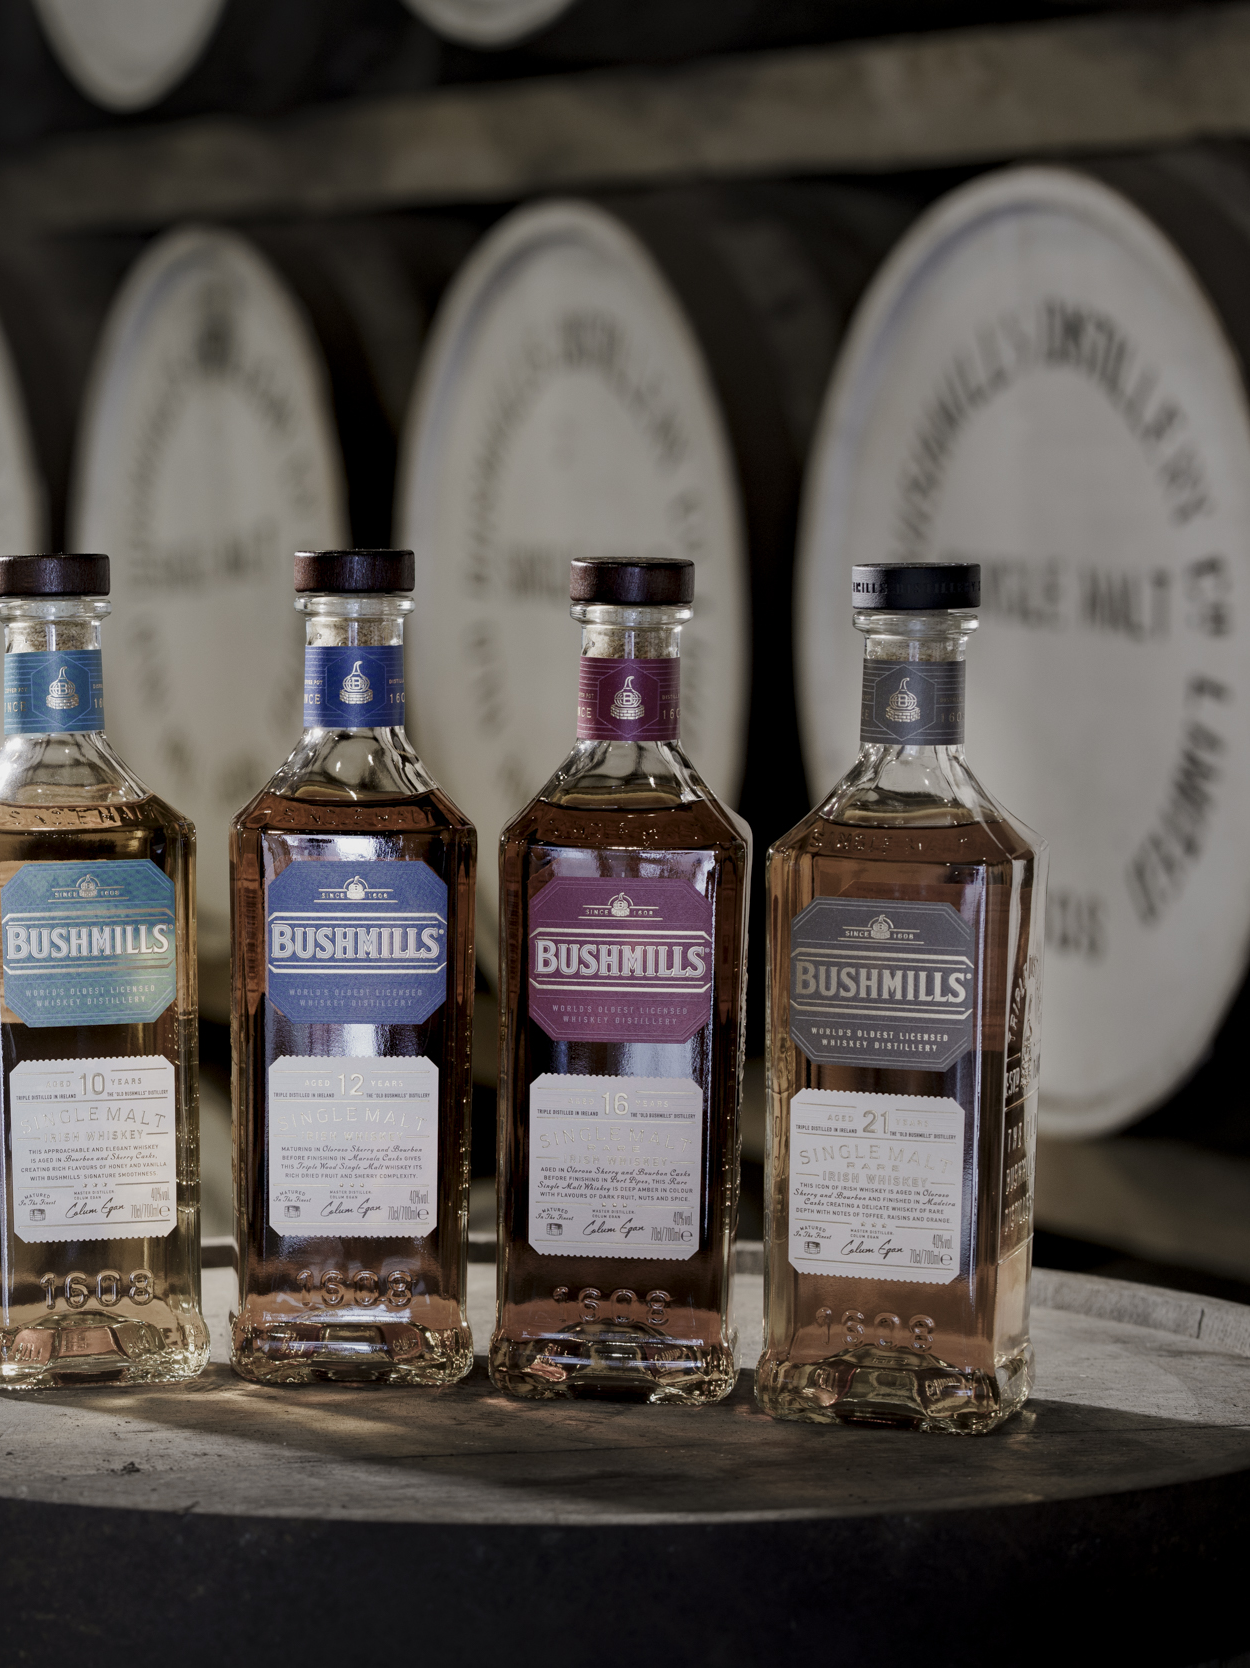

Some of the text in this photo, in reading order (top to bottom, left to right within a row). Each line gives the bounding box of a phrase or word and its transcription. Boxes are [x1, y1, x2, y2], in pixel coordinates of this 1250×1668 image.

[6, 923, 169, 959] BUSHMILLS
[271, 924, 439, 959] BUSHMILLS
[535, 940, 706, 978] BUSHMILLS
[70, 987, 104, 995] OLDEST
[111, 985, 155, 993] LICENSED
[796, 962, 966, 1003] BUSHMILLS
[37, 996, 145, 1007] WHISKEY DISTILLERY
[640, 1007, 688, 1015] LICENSED
[563, 1016, 677, 1025] WHISKEY DISTILLERY
[812, 1028, 948, 1041] WORLD'S OLDEST LICENSED
[822, 1039, 937, 1051] WHISKEY DISTILLERY
[79, 1073, 105, 1095] 10
[337, 1074, 364, 1096] 12
[602, 1092, 628, 1115] 16
[21, 1107, 166, 1134] SINGLE MALT
[278, 1108, 427, 1131] SINGLE MALT
[827, 1114, 854, 1122] AGED
[863, 1110, 889, 1134] 21
[44, 1130, 143, 1142] IRISH WHISKEY
[302, 1132, 402, 1141] IRISH WHISKEY
[540, 1127, 692, 1152] SINGLE MALT
[564, 1154, 668, 1167] IRISH WHISKEY
[800, 1144, 952, 1174] SINGLE MALT
[847, 1162, 899, 1171] RARE
[823, 1171, 928, 1187] IRISH WHISKEY
[794, 1188, 817, 1199] Sherry
[835, 1192, 866, 1201] Bourbon
[922, 1198, 955, 1207] Madeira
[804, 1198, 824, 1206] Casks
[922, 1189, 949, 1198] Oloroso
[40, 1269, 155, 1310] 1608
